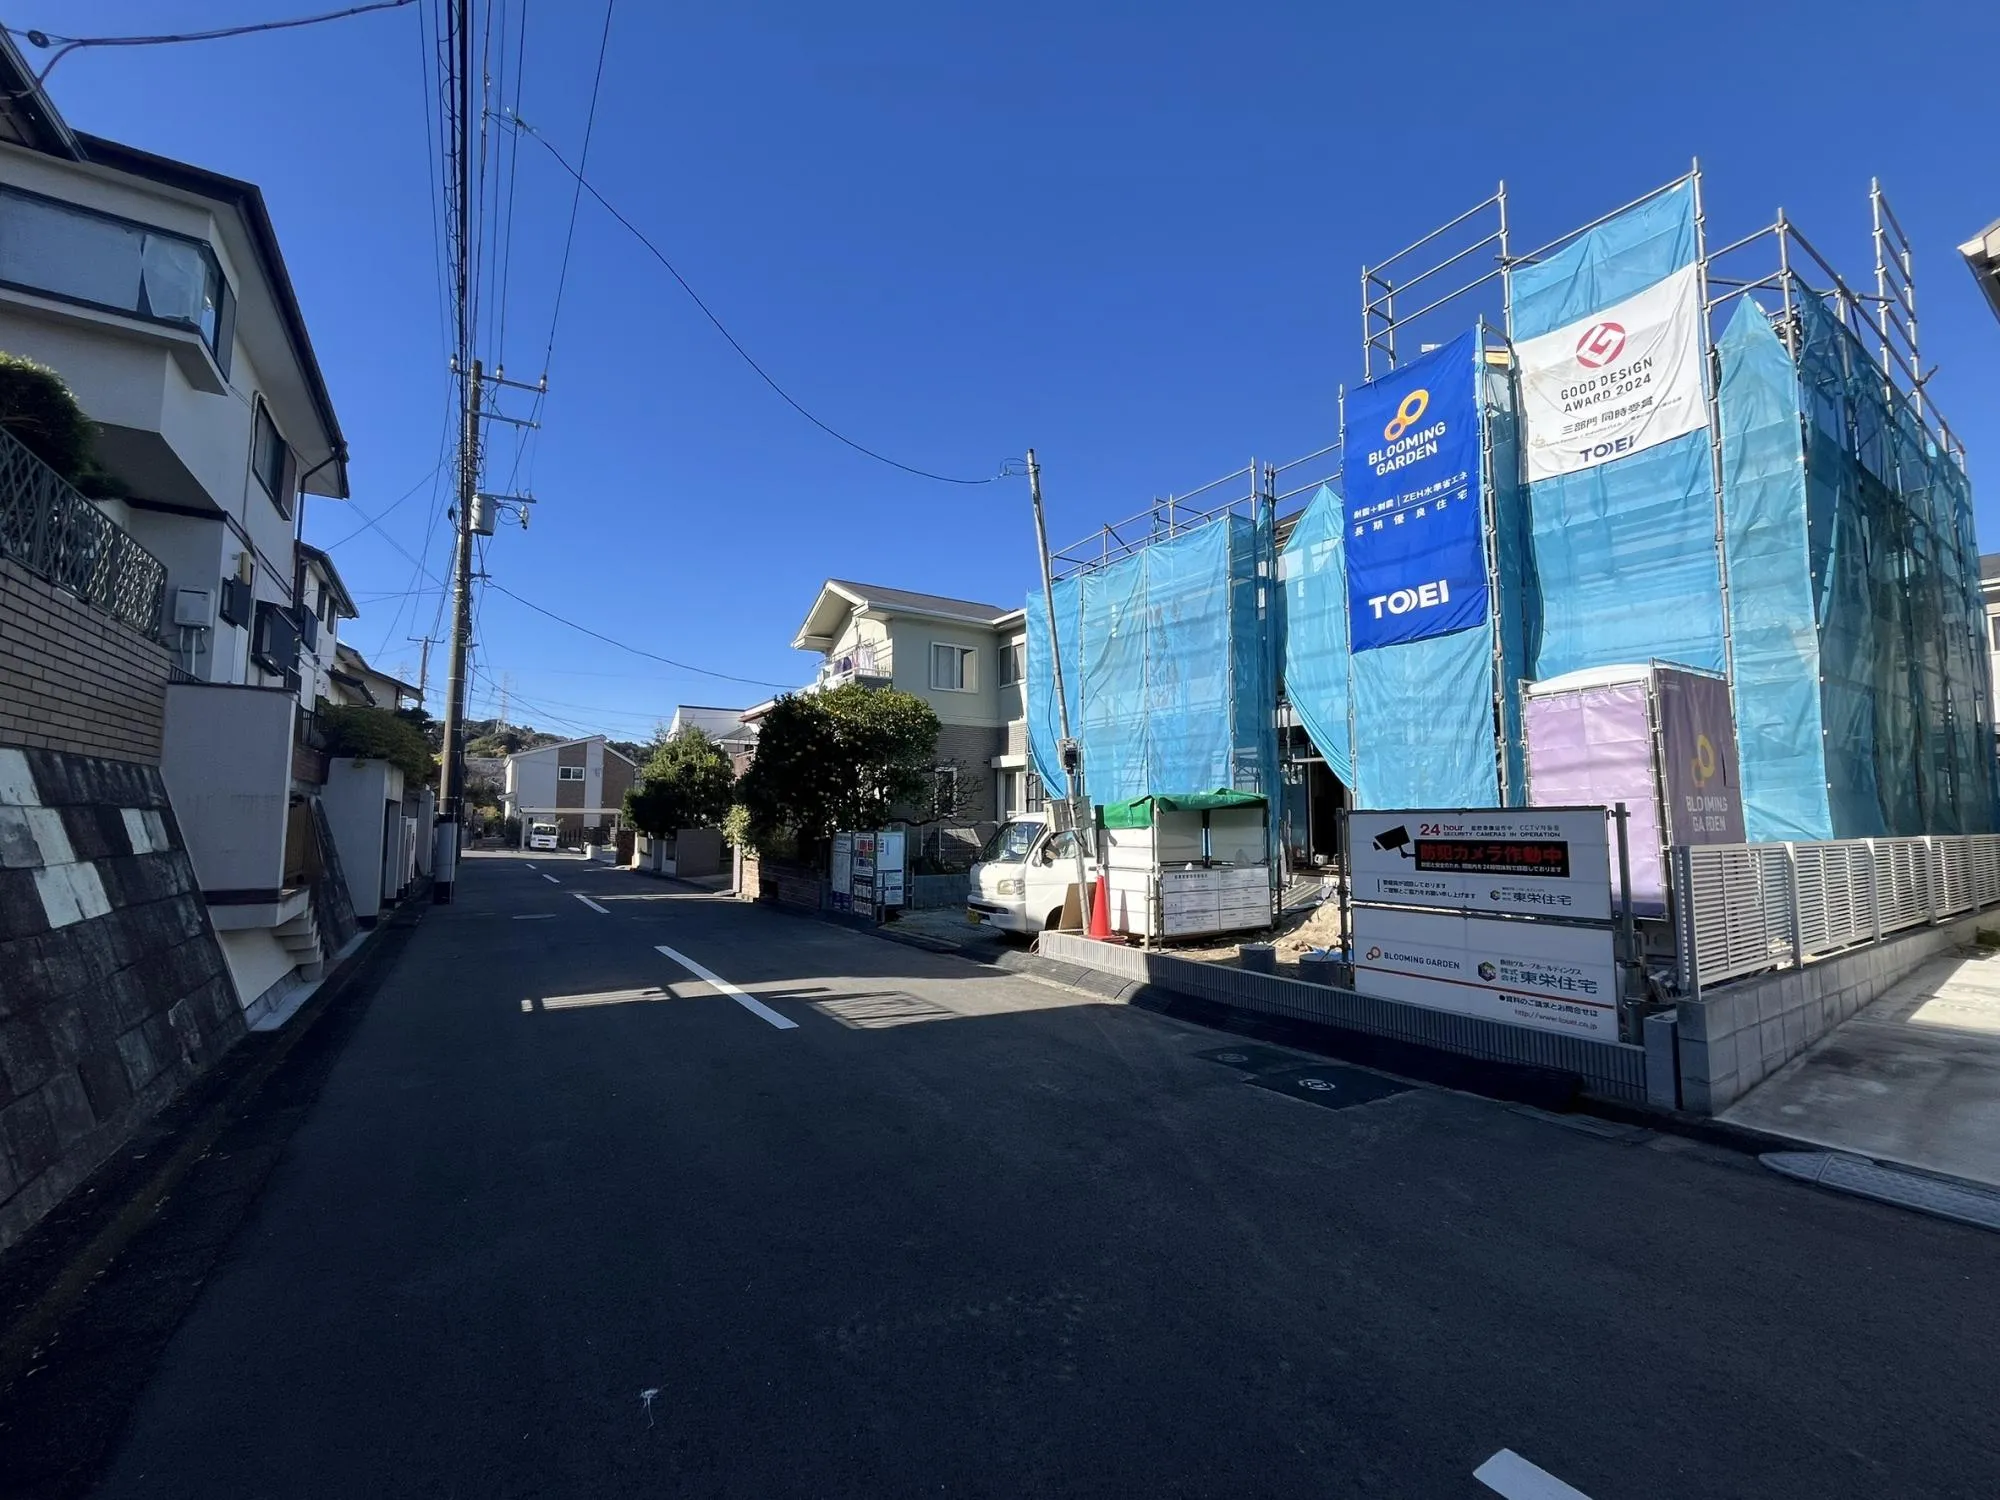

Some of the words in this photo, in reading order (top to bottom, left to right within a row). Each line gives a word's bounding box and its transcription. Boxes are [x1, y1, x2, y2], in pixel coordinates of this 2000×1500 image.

[1561, 380, 1596, 401] GOOD
[1600, 357, 1653, 385] DESIGN
[1564, 390, 1611, 413] AWARD
[1616, 374, 1652, 396] 2024
[1368, 421, 1446, 466] BLOOMING
[1579, 435, 1635, 462] TOEI
[1375, 444, 1438, 477] GARDEN
[1368, 579, 1450, 620] TOEI
[1420, 823, 1441, 836] 24
[1443, 823, 1464, 832] hour
[1420, 844, 1563, 864] 防犯カメラ作動中
[1512, 892, 1572, 906] 東栄住宅
[1384, 951, 1424, 964] BLOOMING
[1426, 957, 1460, 970] GARDEN
[1519, 970, 1598, 994] 東栄住宅
